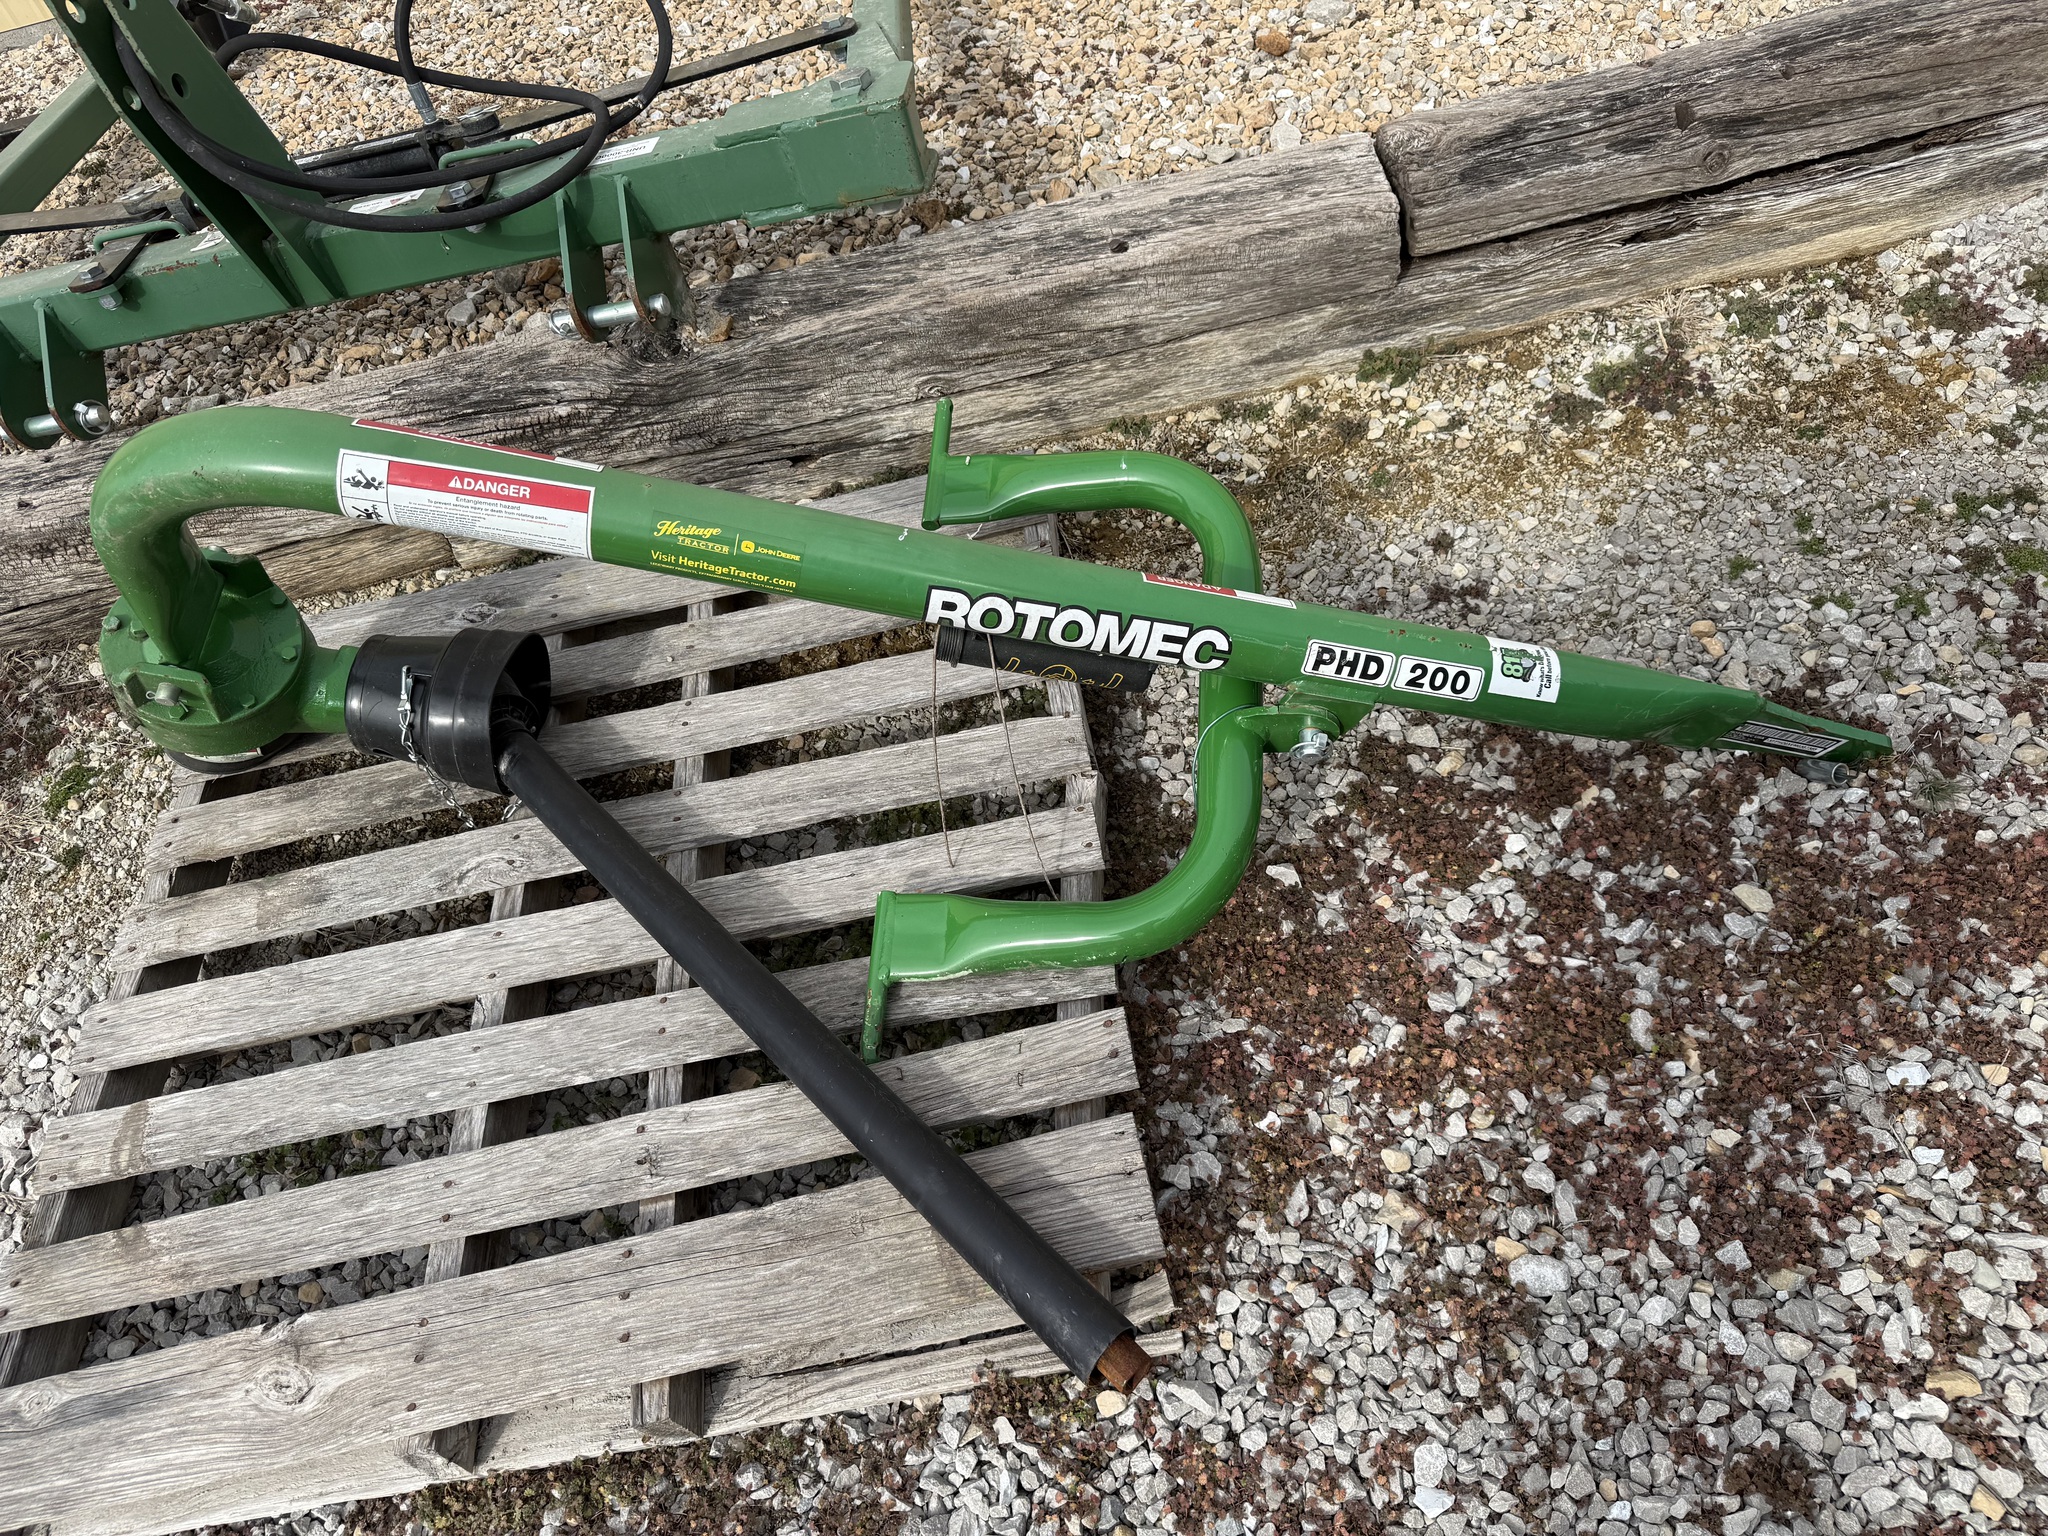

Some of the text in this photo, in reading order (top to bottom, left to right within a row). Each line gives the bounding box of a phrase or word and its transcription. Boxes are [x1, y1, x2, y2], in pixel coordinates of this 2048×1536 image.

[463, 477, 531, 499] DANGER
[456, 496, 521, 511] Entanglement hazard
[653, 520, 722, 539] Heritage
[677, 536, 730, 554] TRACTOR
[755, 546, 801, 561] JOHN DEERE
[651, 549, 797, 588] Visit HeritageTractor.com
[924, 585, 1232, 671] ROTOMEC
[1311, 645, 1471, 695] PHD 200
[1500, 647, 1524, 679] 81
[1544, 674, 1552, 689] Call
